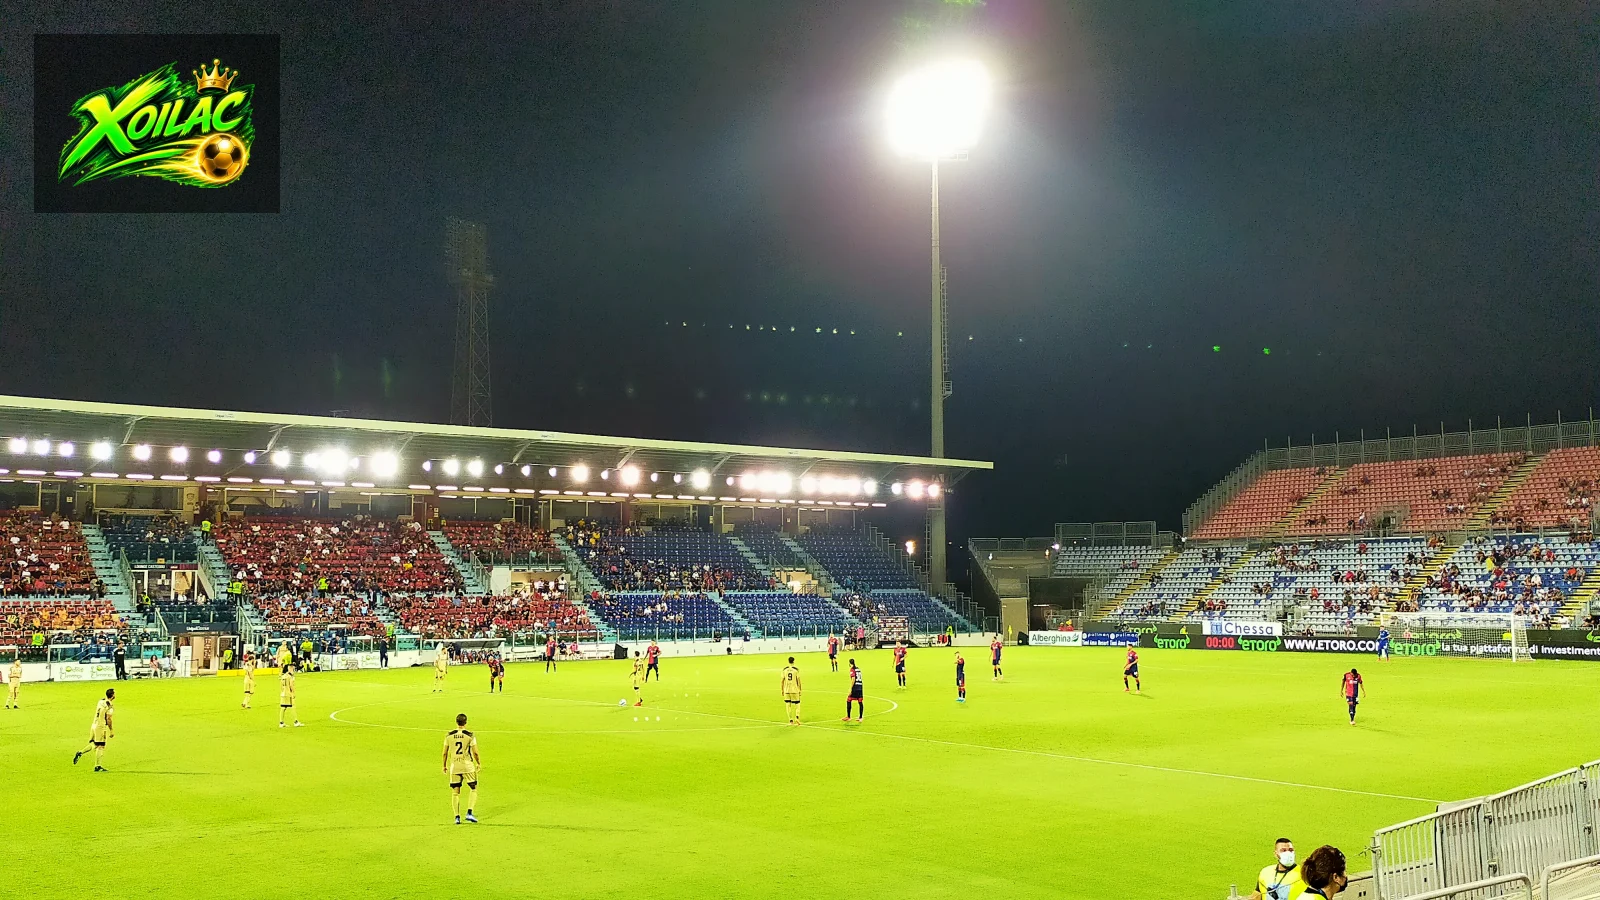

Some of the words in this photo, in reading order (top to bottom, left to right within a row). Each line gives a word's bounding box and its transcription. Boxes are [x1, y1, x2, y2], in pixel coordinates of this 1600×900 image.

[1224, 622, 1274, 635] Chessa
[1032, 633, 1071, 644] Alberghina
[1206, 637, 1234, 648] 00:00
[1442, 643, 1450, 652] la
[1452, 643, 1468, 652] tua
[1529, 644, 1538, 653] di
[788, 673, 793, 681] 9
[455, 741, 463, 755] 2
